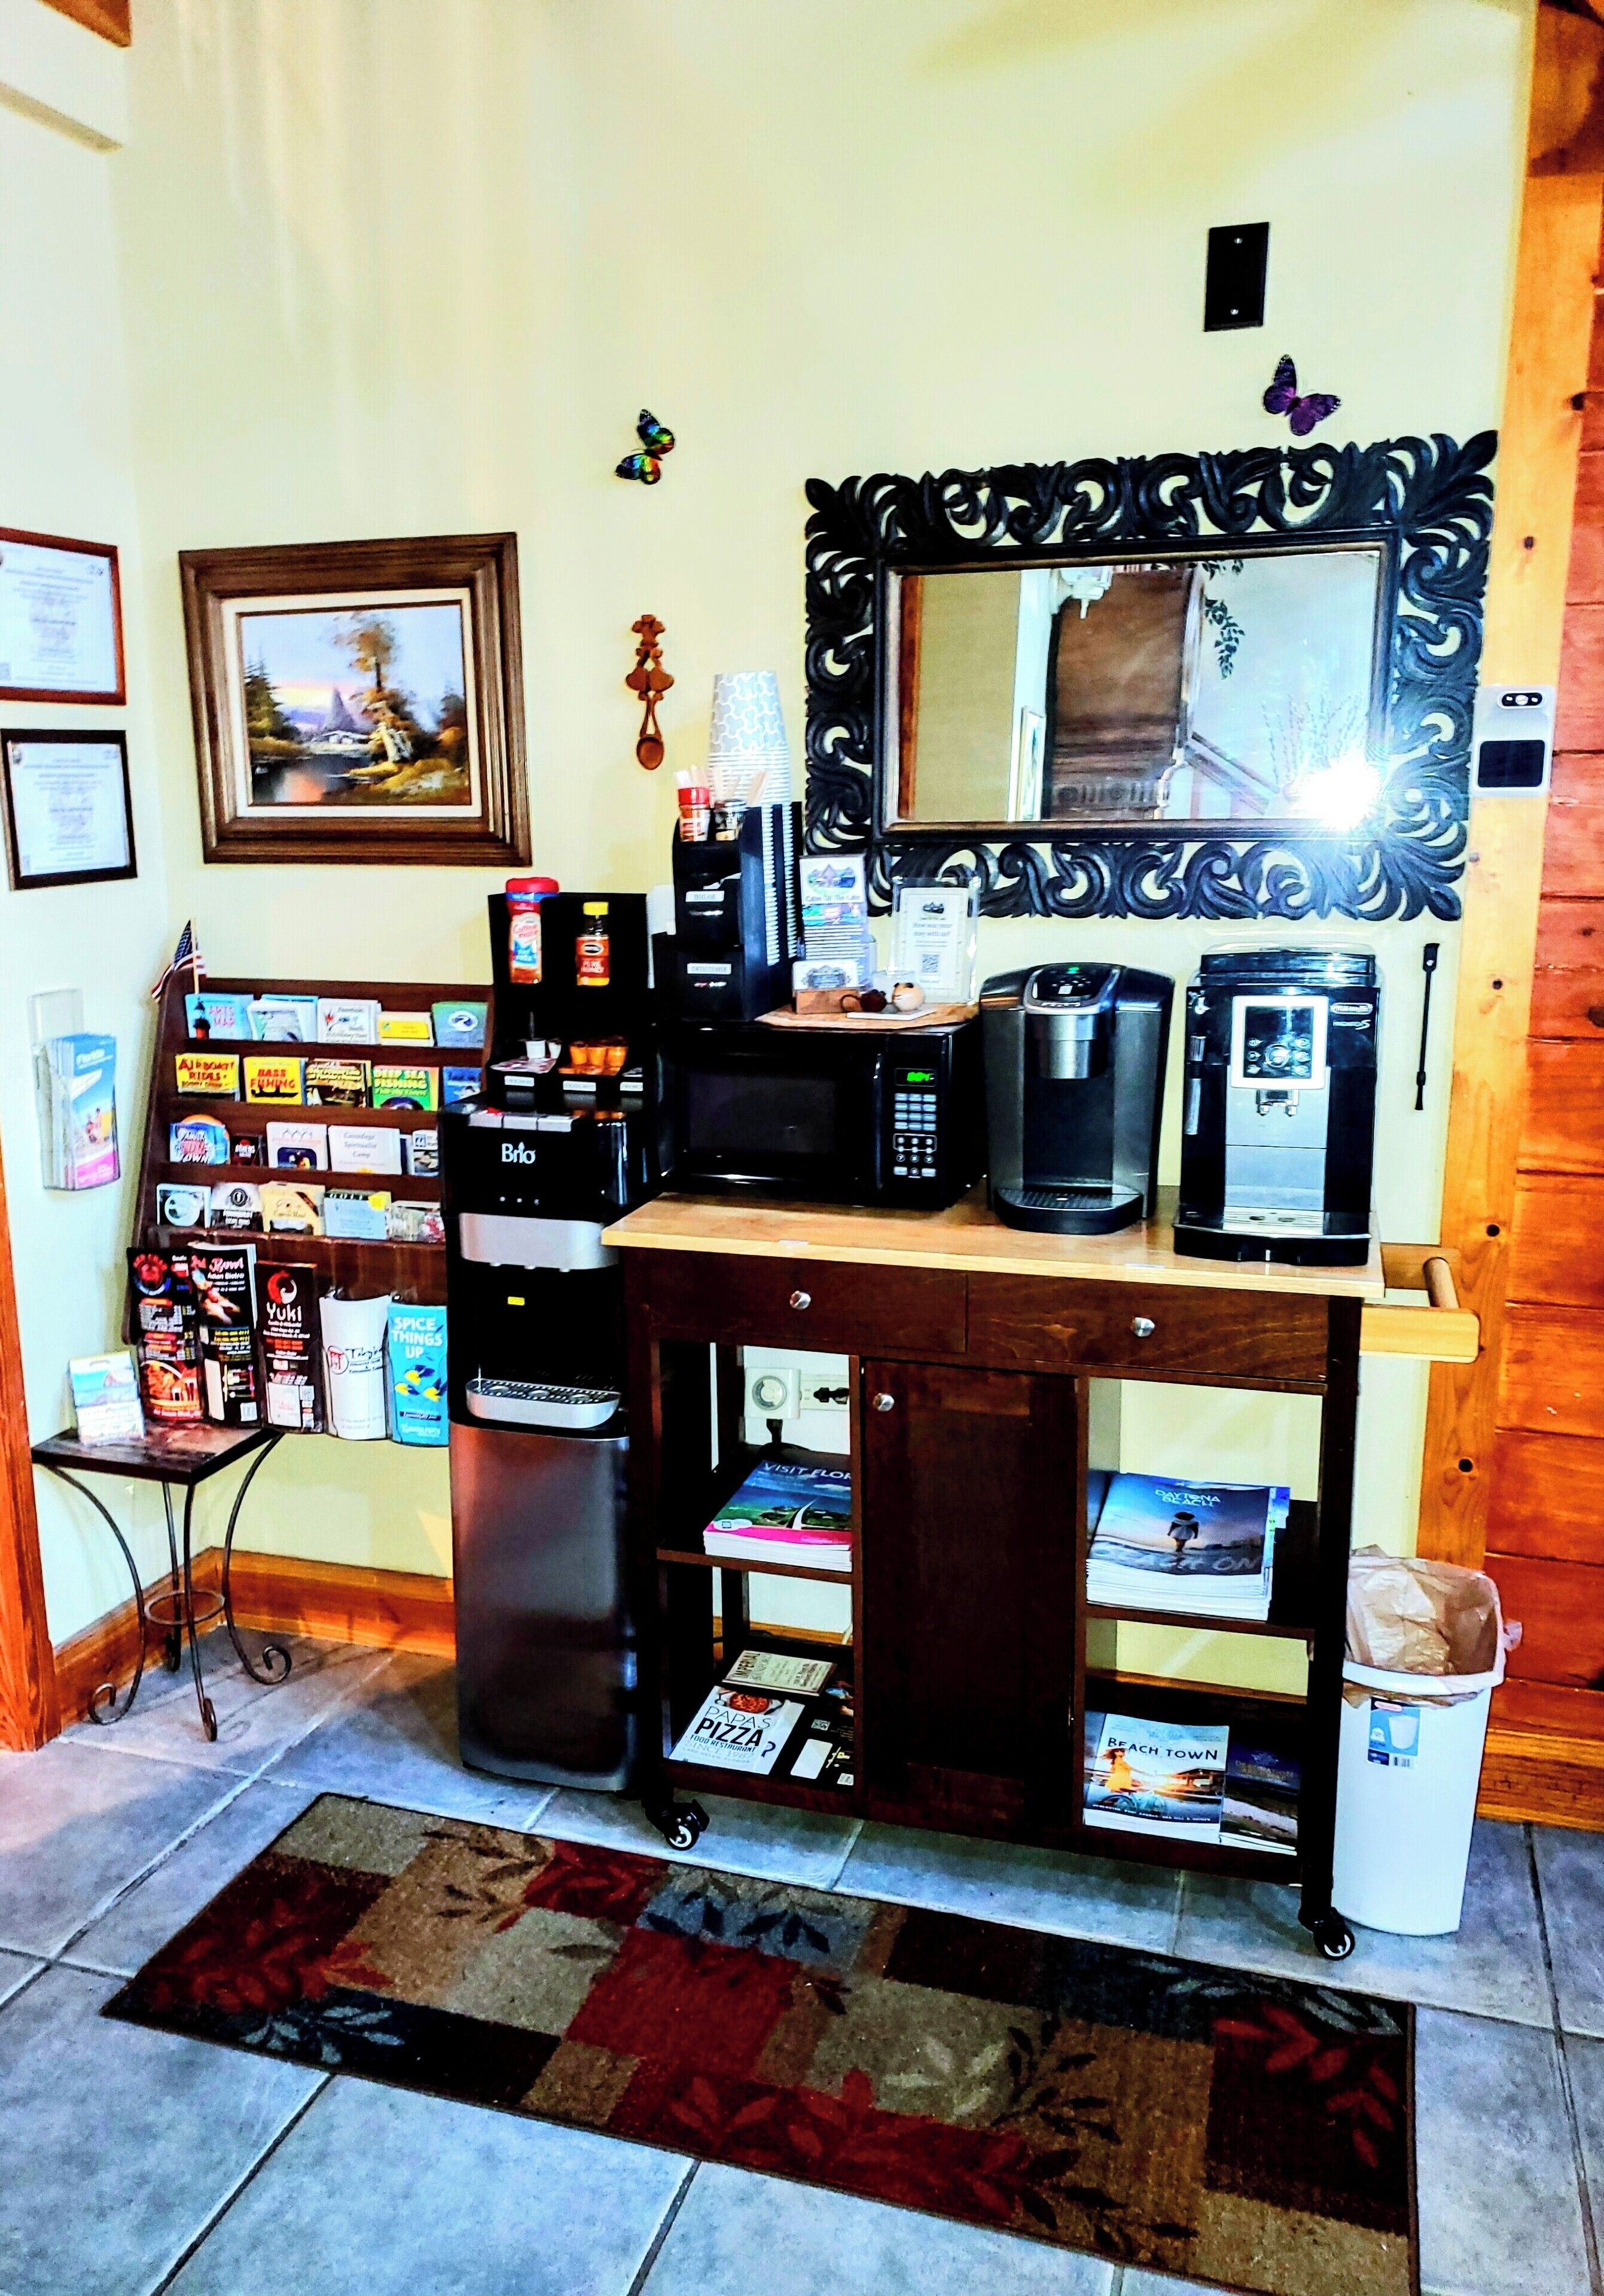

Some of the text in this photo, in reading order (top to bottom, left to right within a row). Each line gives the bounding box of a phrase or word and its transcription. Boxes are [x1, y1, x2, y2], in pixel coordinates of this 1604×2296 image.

[178, 1058, 235, 1071] AIRBOAT
[257, 1069, 287, 1077] BASS
[374, 1069, 426, 1080] DEEP SEA
[250, 1078, 296, 1089] FISHING
[501, 1141, 536, 1165] Brio
[266, 1302, 302, 1321] Yuki
[394, 1317, 437, 1330] SPICE
[391, 1331, 443, 1347] THINGS
[405, 1346, 425, 1359] UP
[763, 1463, 807, 1474] VISIT
[1155, 1489, 1221, 1503] DAYTONA
[1161, 1495, 1213, 1507] BEACH
[705, 1706, 772, 1729] PAPAS
[694, 1717, 764, 1747] PIZZA
[690, 1734, 710, 1745] FOOD
[710, 1741, 757, 1752] RESTAURANT
[1107, 1736, 1218, 1760] BEACH TOWN
